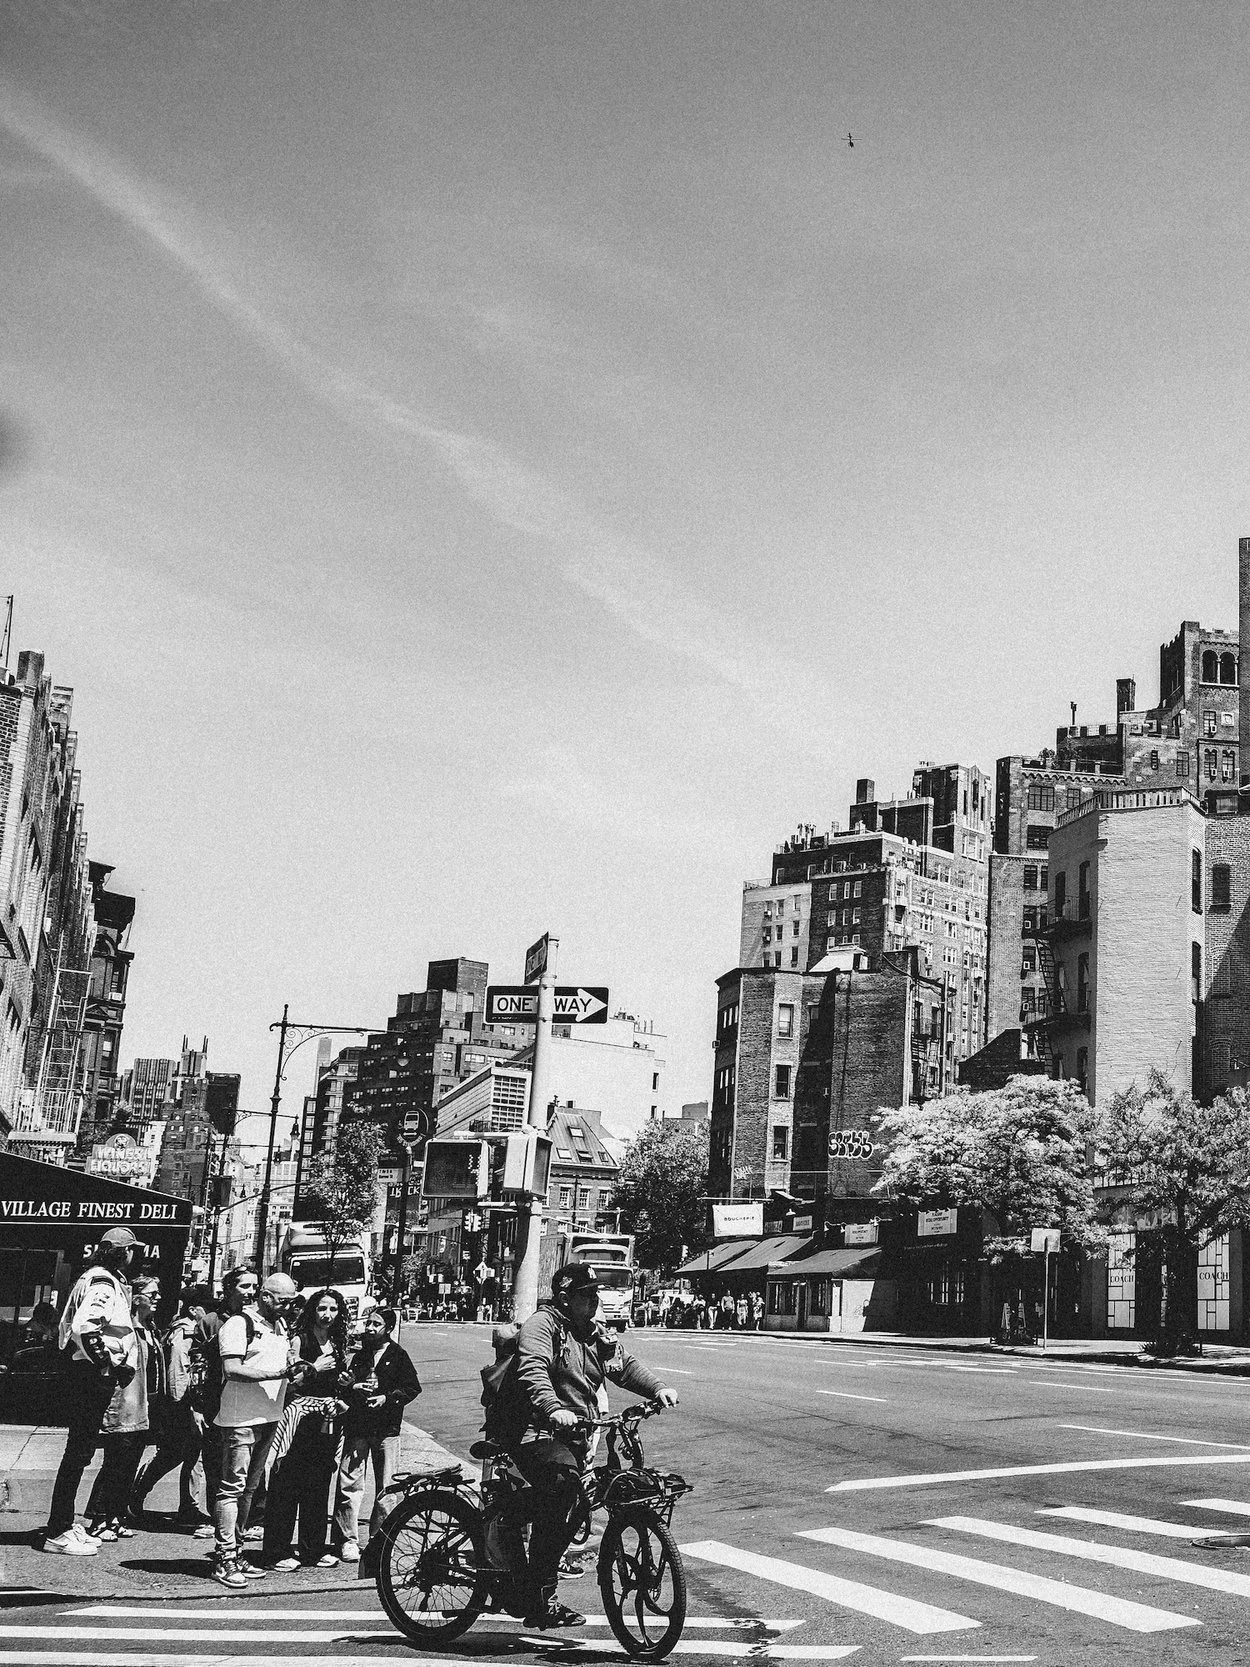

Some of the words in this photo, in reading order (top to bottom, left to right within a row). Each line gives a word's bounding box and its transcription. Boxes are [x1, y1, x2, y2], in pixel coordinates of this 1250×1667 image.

[497, 997, 533, 1012] ONE
[554, 998, 593, 1013] WAY
[1, 1200, 71, 1218] VILLAGE
[77, 1202, 135, 1219] FINEST
[139, 1203, 178, 1220] DELI
[1110, 1275, 1134, 1283] COACH
[1199, 1271, 1229, 1281] COACH
